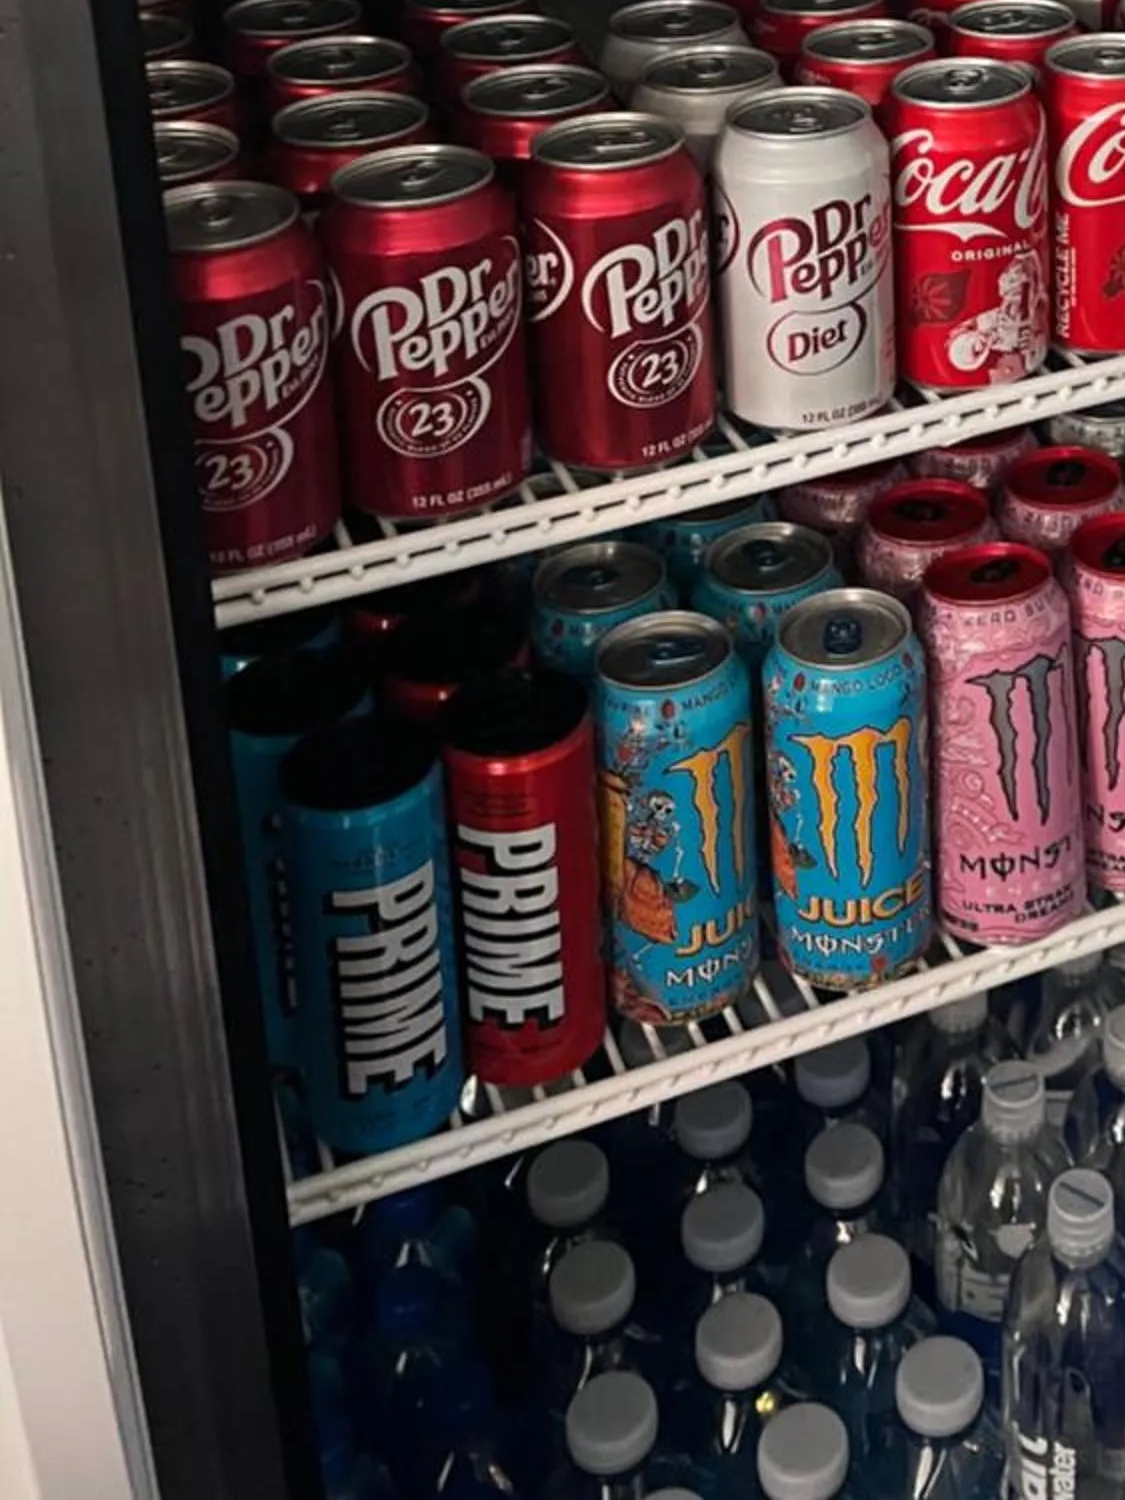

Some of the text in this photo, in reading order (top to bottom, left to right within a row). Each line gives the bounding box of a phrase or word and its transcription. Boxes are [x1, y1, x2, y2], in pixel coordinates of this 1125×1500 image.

[812, 193, 873, 259] Dr
[951, 239, 1031, 262] ORIGINAL
[420, 257, 493, 328] Dr
[216, 304, 295, 378] Dr
[352, 258, 520, 382] Pepper
[788, 319, 849, 363] Diet
[641, 349, 679, 389] 23
[408, 401, 455, 438] 23
[204, 452, 255, 490] 23
[457, 821, 566, 1025] PRIME
[799, 874, 925, 928] JUICE
[962, 900, 1018, 914] ULTRA
[331, 858, 449, 1096] PRIME
